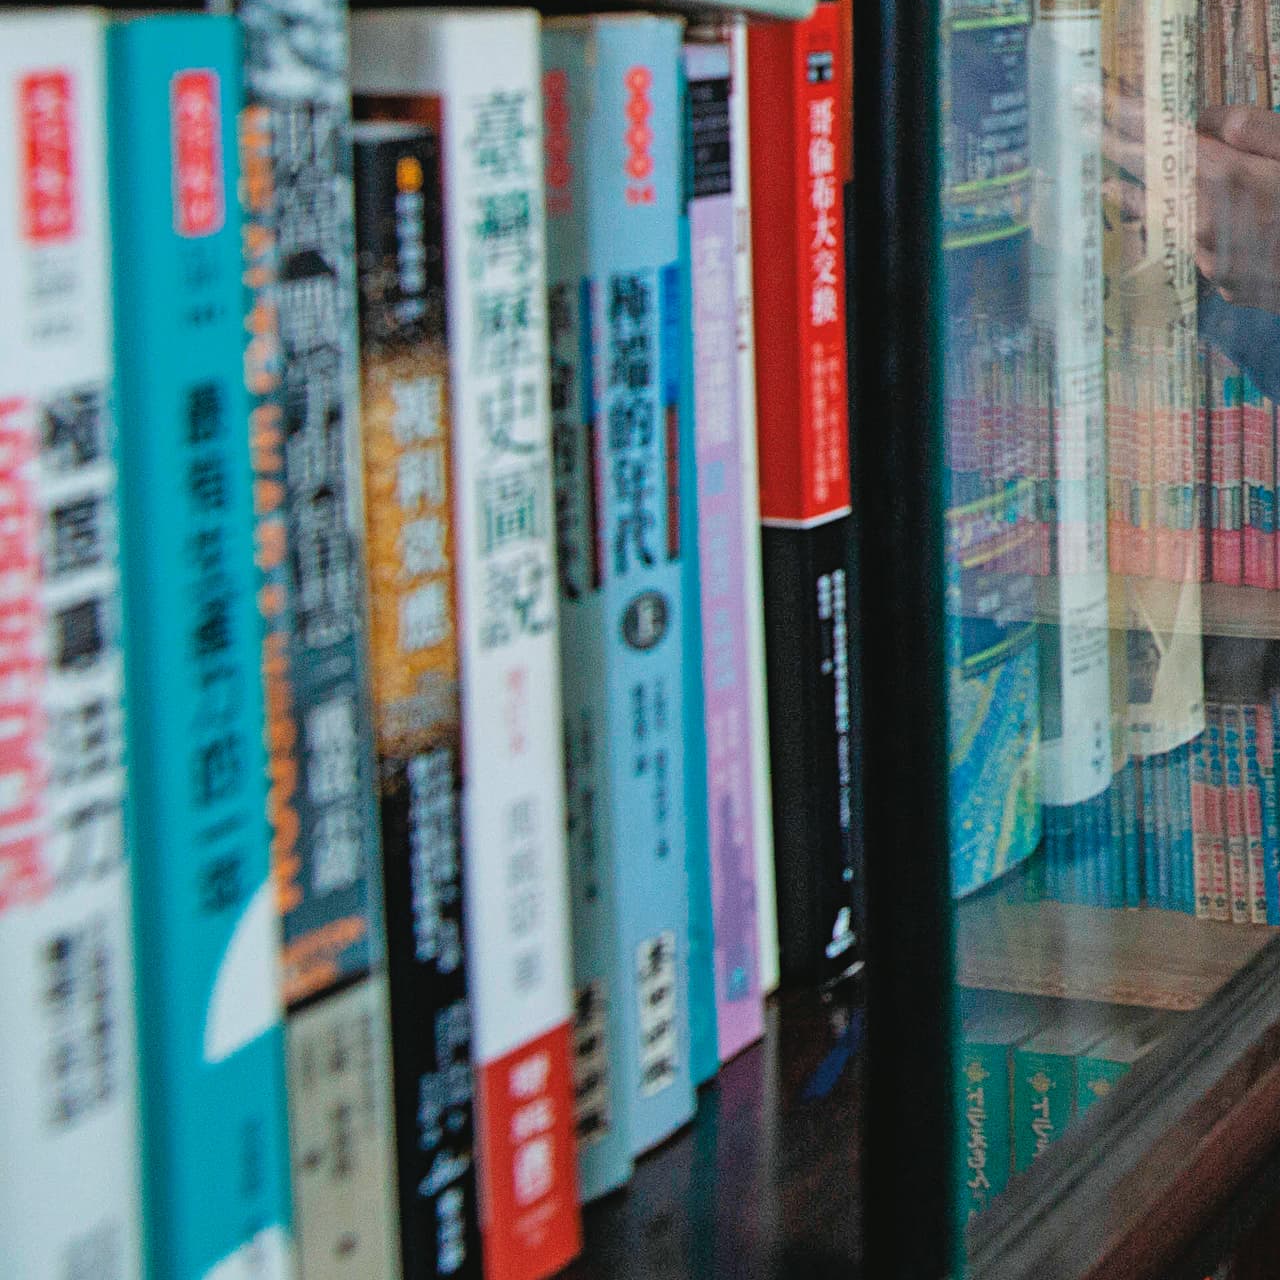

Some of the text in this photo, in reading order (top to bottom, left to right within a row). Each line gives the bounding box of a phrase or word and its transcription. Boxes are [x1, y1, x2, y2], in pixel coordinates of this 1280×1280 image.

[1160, 20, 1175, 64] THE
[1161, 69, 1176, 147] BIRTH
[1163, 153, 1177, 182] OF
